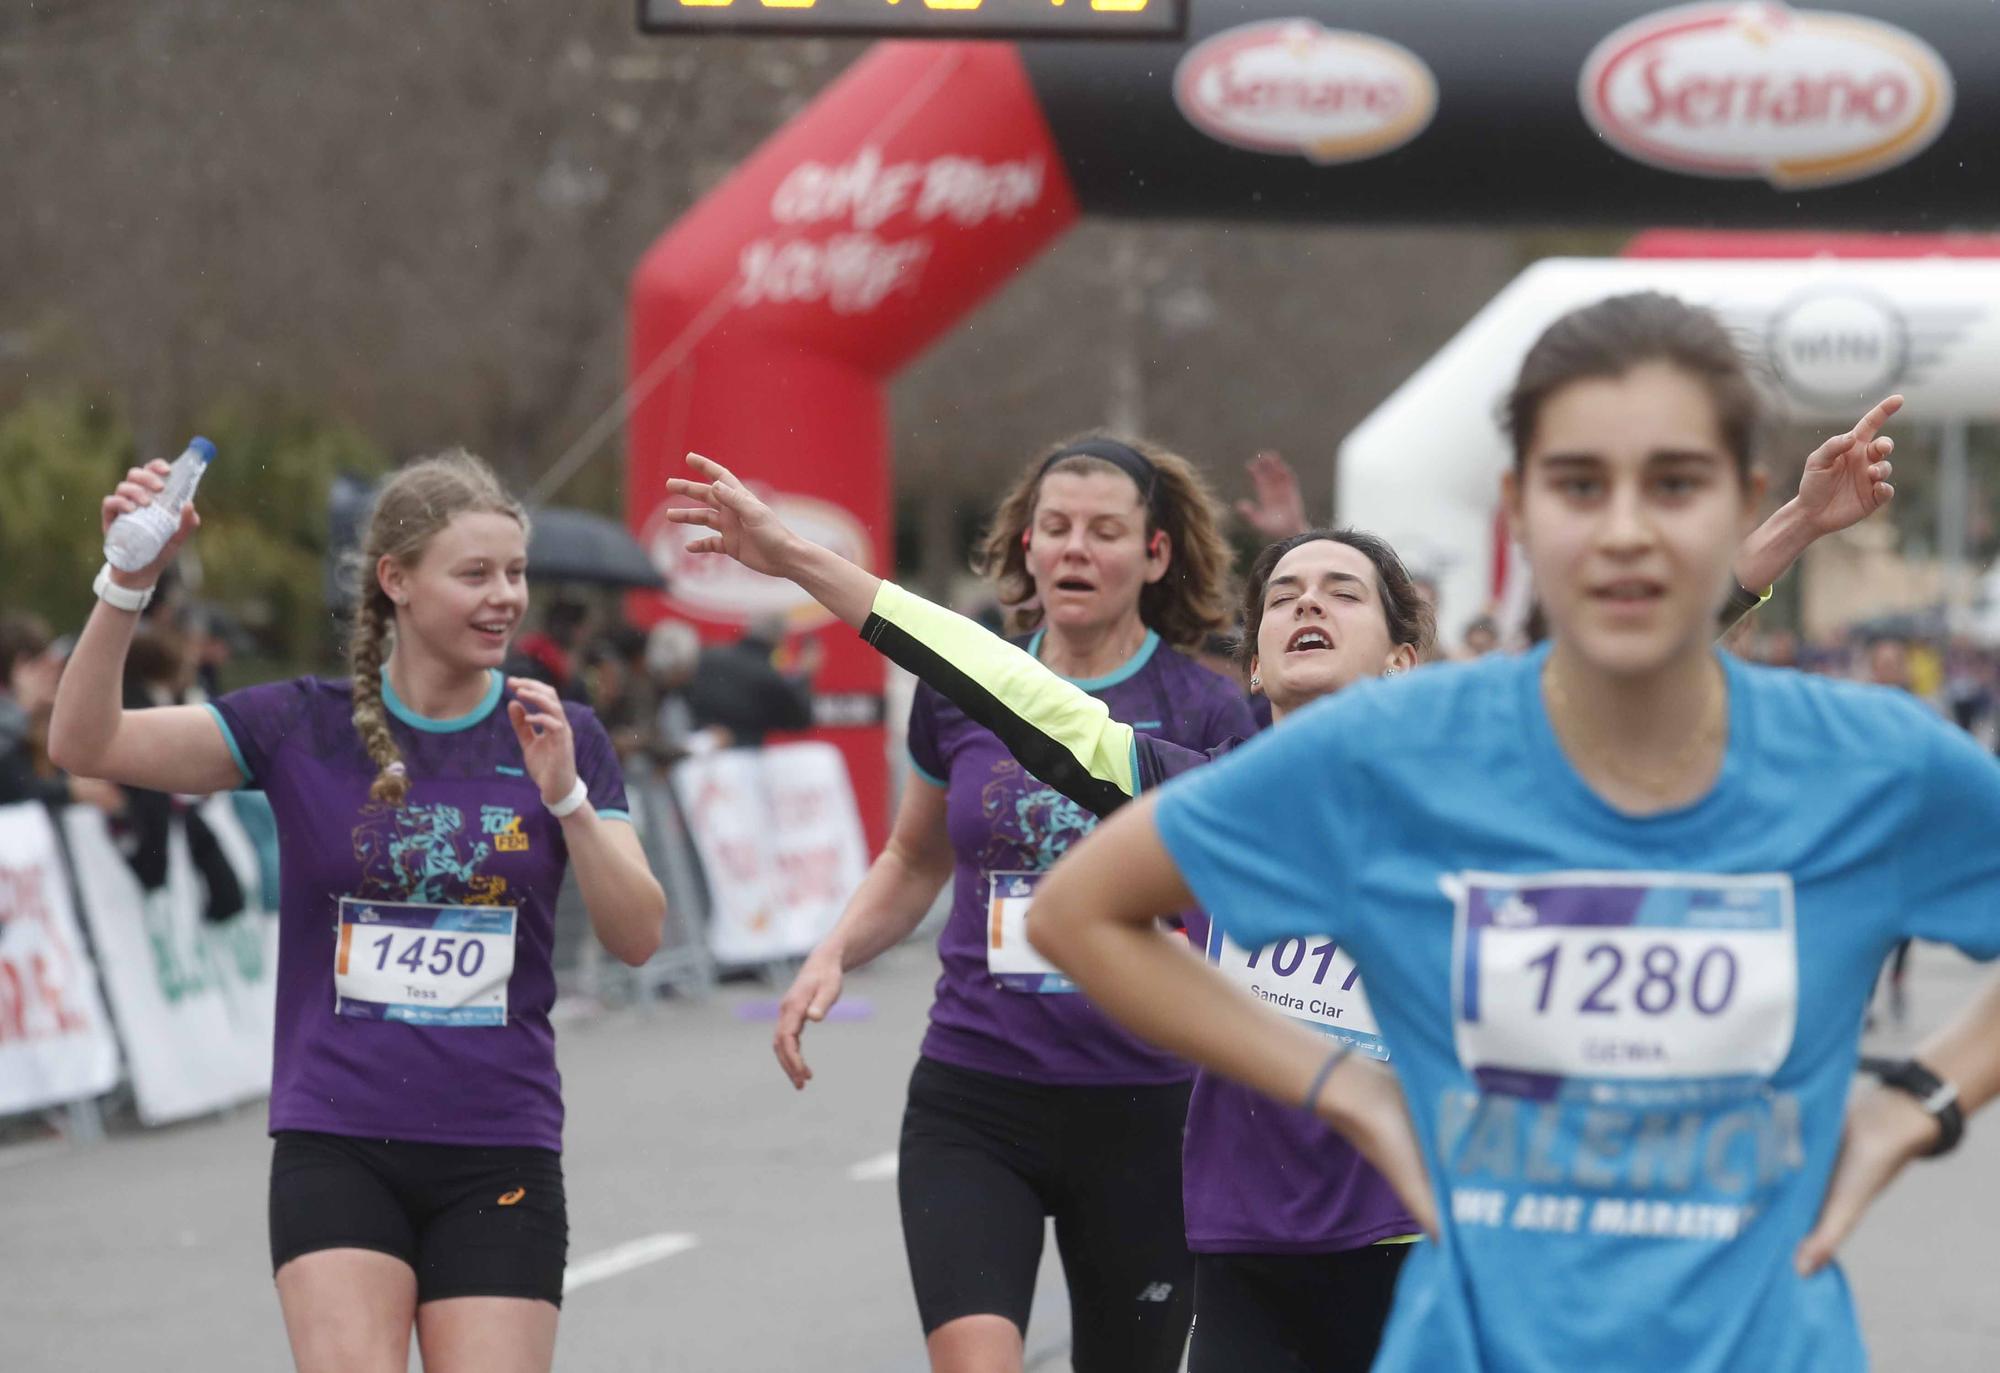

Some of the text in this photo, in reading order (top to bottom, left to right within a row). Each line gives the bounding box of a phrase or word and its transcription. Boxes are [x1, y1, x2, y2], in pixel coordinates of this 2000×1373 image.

[1638, 55, 1908, 128] Serrano
[373, 933, 485, 977] 1450
[405, 986, 438, 999] Tess
[1251, 984, 1344, 1019] Sandra Clar
[1527, 943, 1738, 1016] 1280
